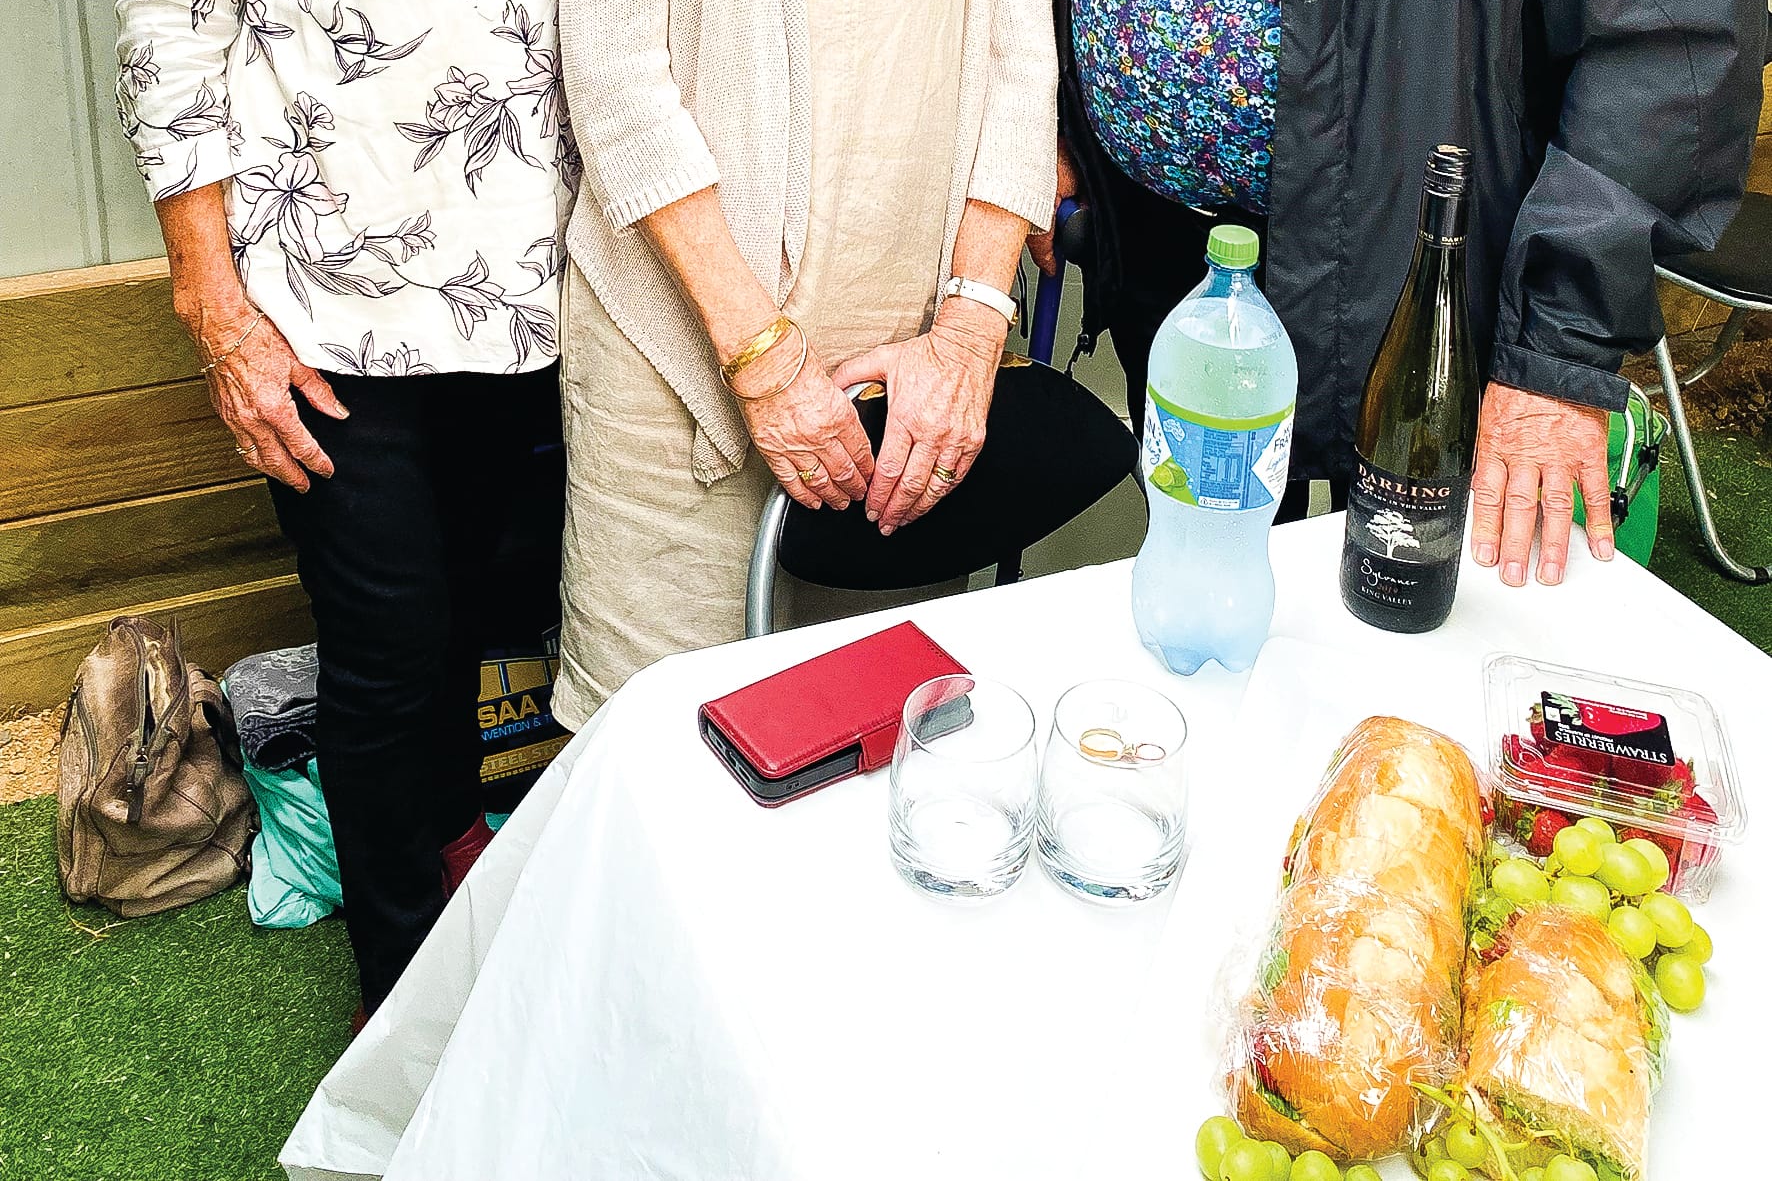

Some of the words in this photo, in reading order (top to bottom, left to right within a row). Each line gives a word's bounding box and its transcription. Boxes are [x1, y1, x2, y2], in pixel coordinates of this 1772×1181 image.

[1358, 462, 1450, 498] DARLING
[1360, 557, 1420, 587] Sylvaner
[1360, 585, 1380, 599] KING
[1381, 593, 1413, 606] VALLEY
[1555, 730, 1669, 764] STRAWBERRIES
